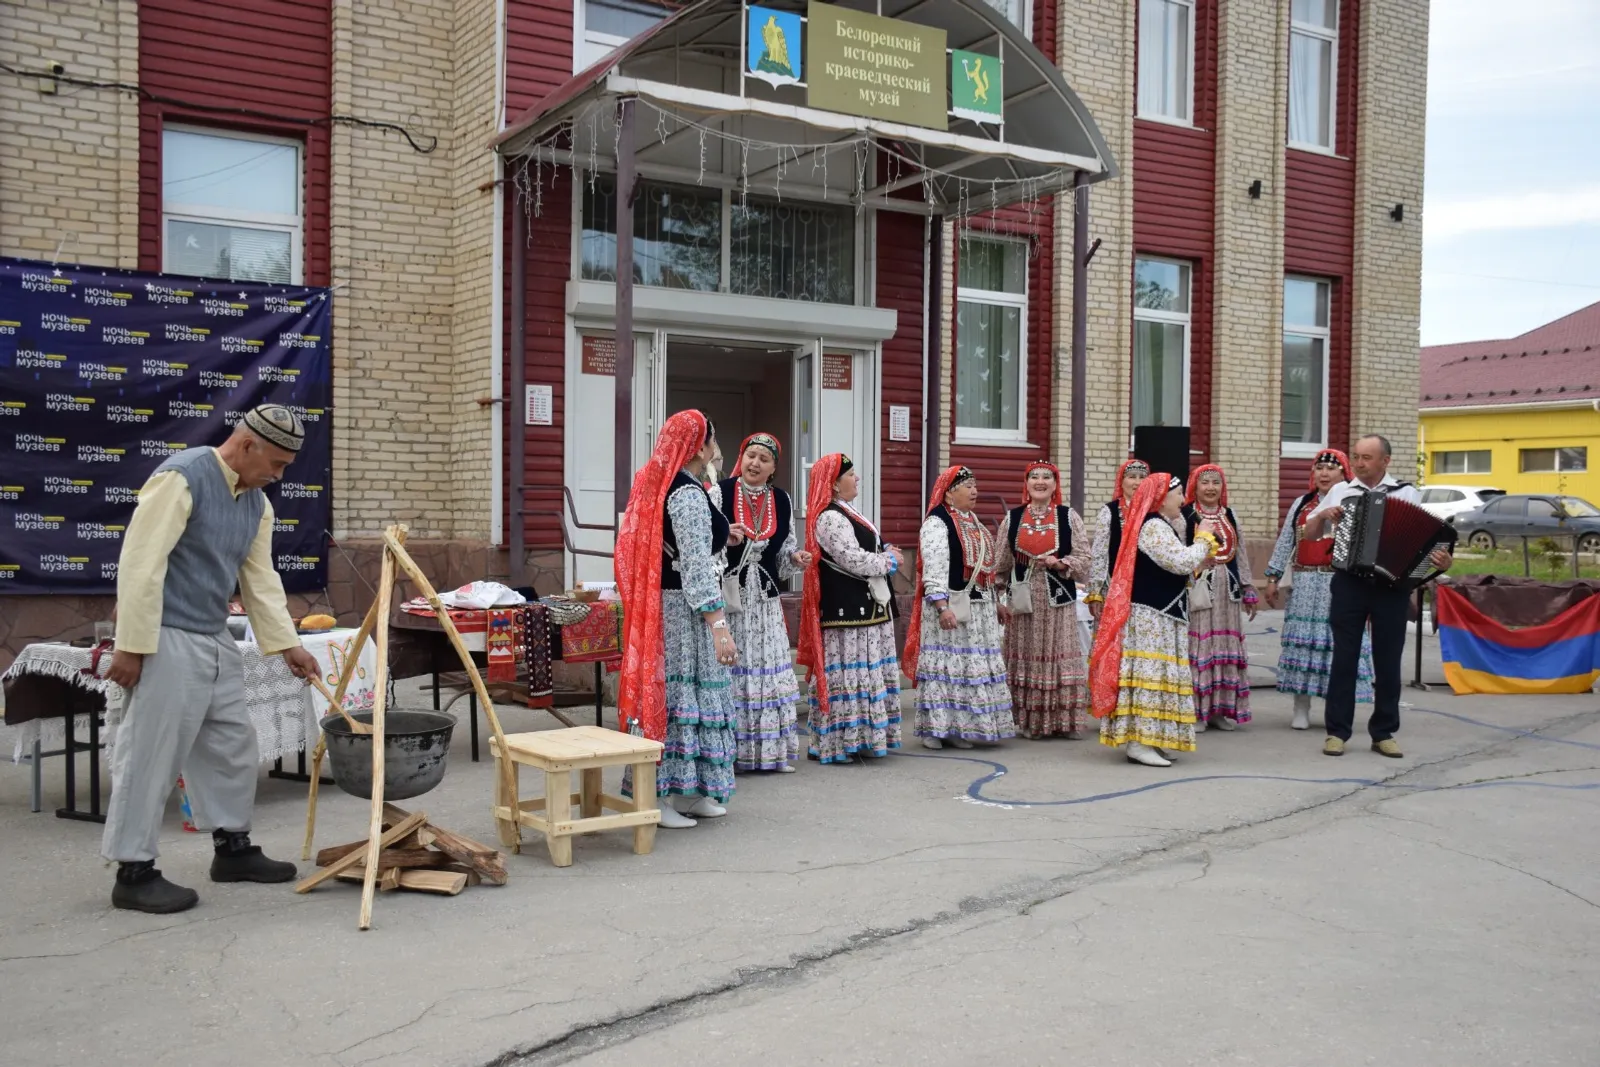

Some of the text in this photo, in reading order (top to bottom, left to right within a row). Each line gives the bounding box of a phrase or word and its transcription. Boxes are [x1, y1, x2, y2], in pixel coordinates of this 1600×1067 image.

[836, 20, 921, 53] Белорецкий
[844, 45, 914, 70] историко-
[825, 62, 931, 94] краеведческий
[860, 88, 900, 106] музей
